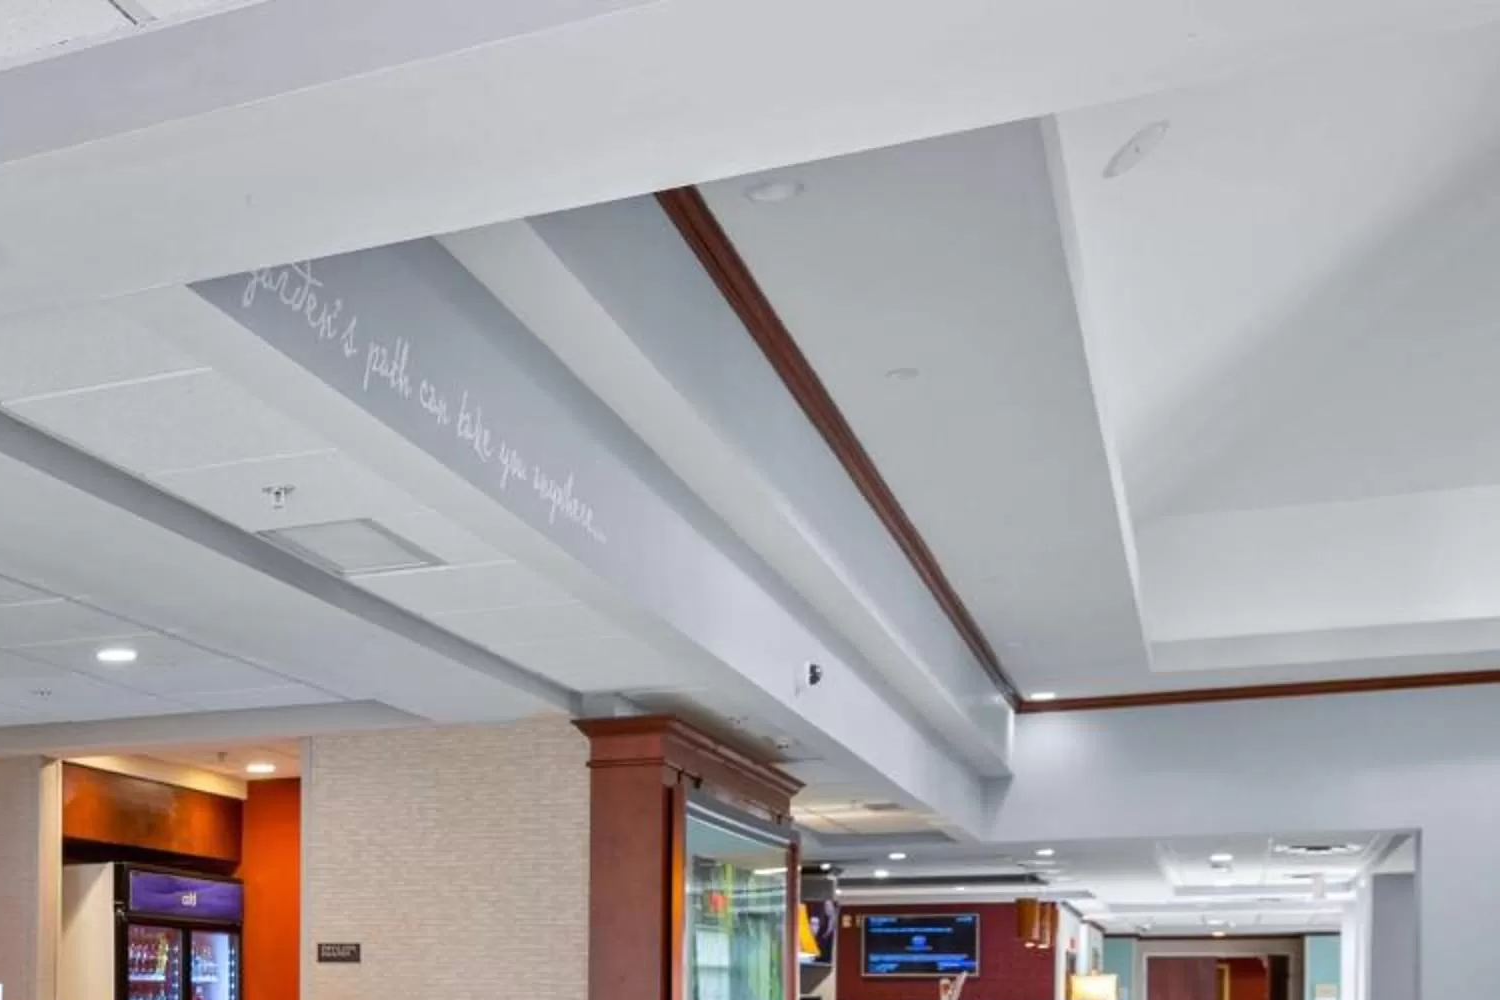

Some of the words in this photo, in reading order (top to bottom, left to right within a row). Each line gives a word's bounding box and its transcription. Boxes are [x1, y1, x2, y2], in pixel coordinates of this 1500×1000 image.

[363, 336, 411, 398] path
[419, 379, 449, 425] can
[457, 390, 494, 463] take
[499, 440, 527, 489] you
